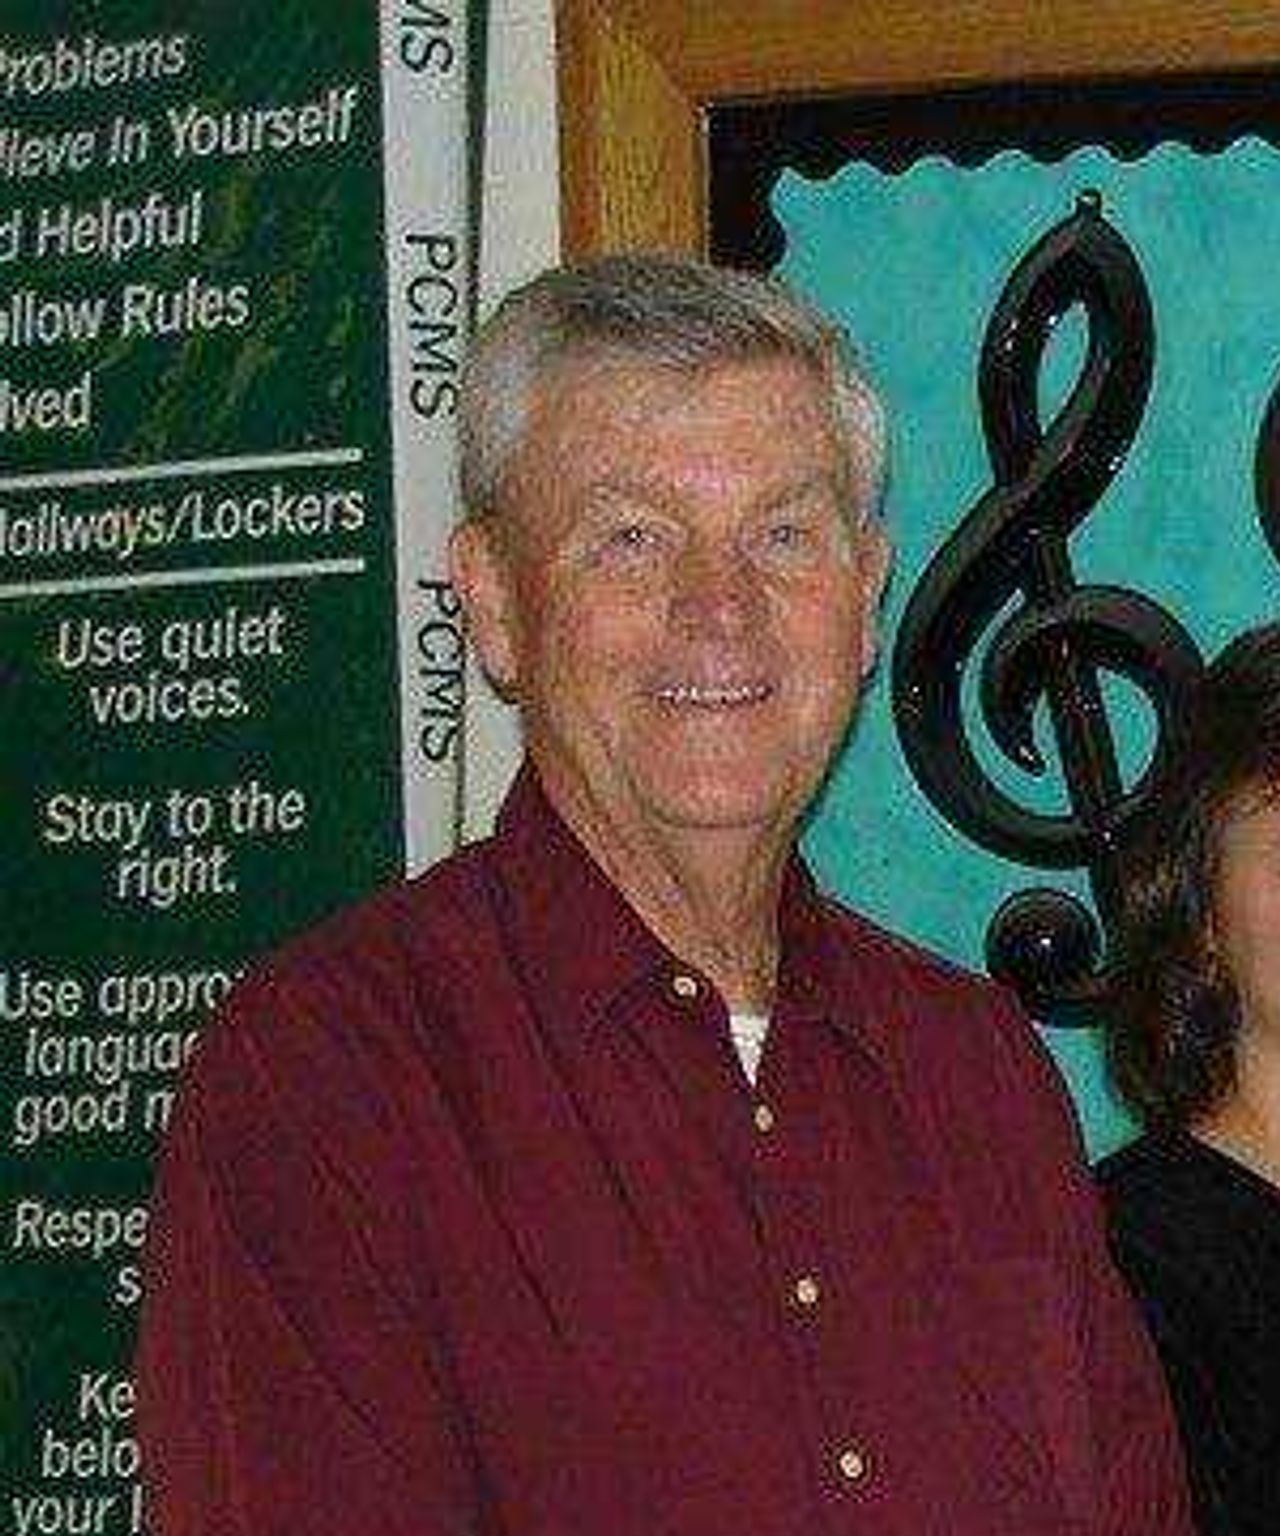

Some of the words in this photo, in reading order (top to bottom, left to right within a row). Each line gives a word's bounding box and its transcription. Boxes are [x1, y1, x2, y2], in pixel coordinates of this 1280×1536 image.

[166, 86, 358, 157] Yourself
[38, 190, 202, 263] Helpful
[122, 276, 250, 338] Rules
[405, 233, 459, 418] PCMS
[57, 617, 143, 670] Use
[161, 604, 284, 672] quiet
[417, 578, 466, 763] PCMS
[90, 672, 250, 725] voices.
[45, 792, 152, 851] Stay
[168, 788, 214, 838] to
[228, 780, 306, 833] the
[117, 843, 238, 906] right.
[0, 970, 82, 1021] Use
[100, 968, 245, 1024] appro
[15, 1080, 130, 1146] good
[13, 1200, 150, 1259] Respe
